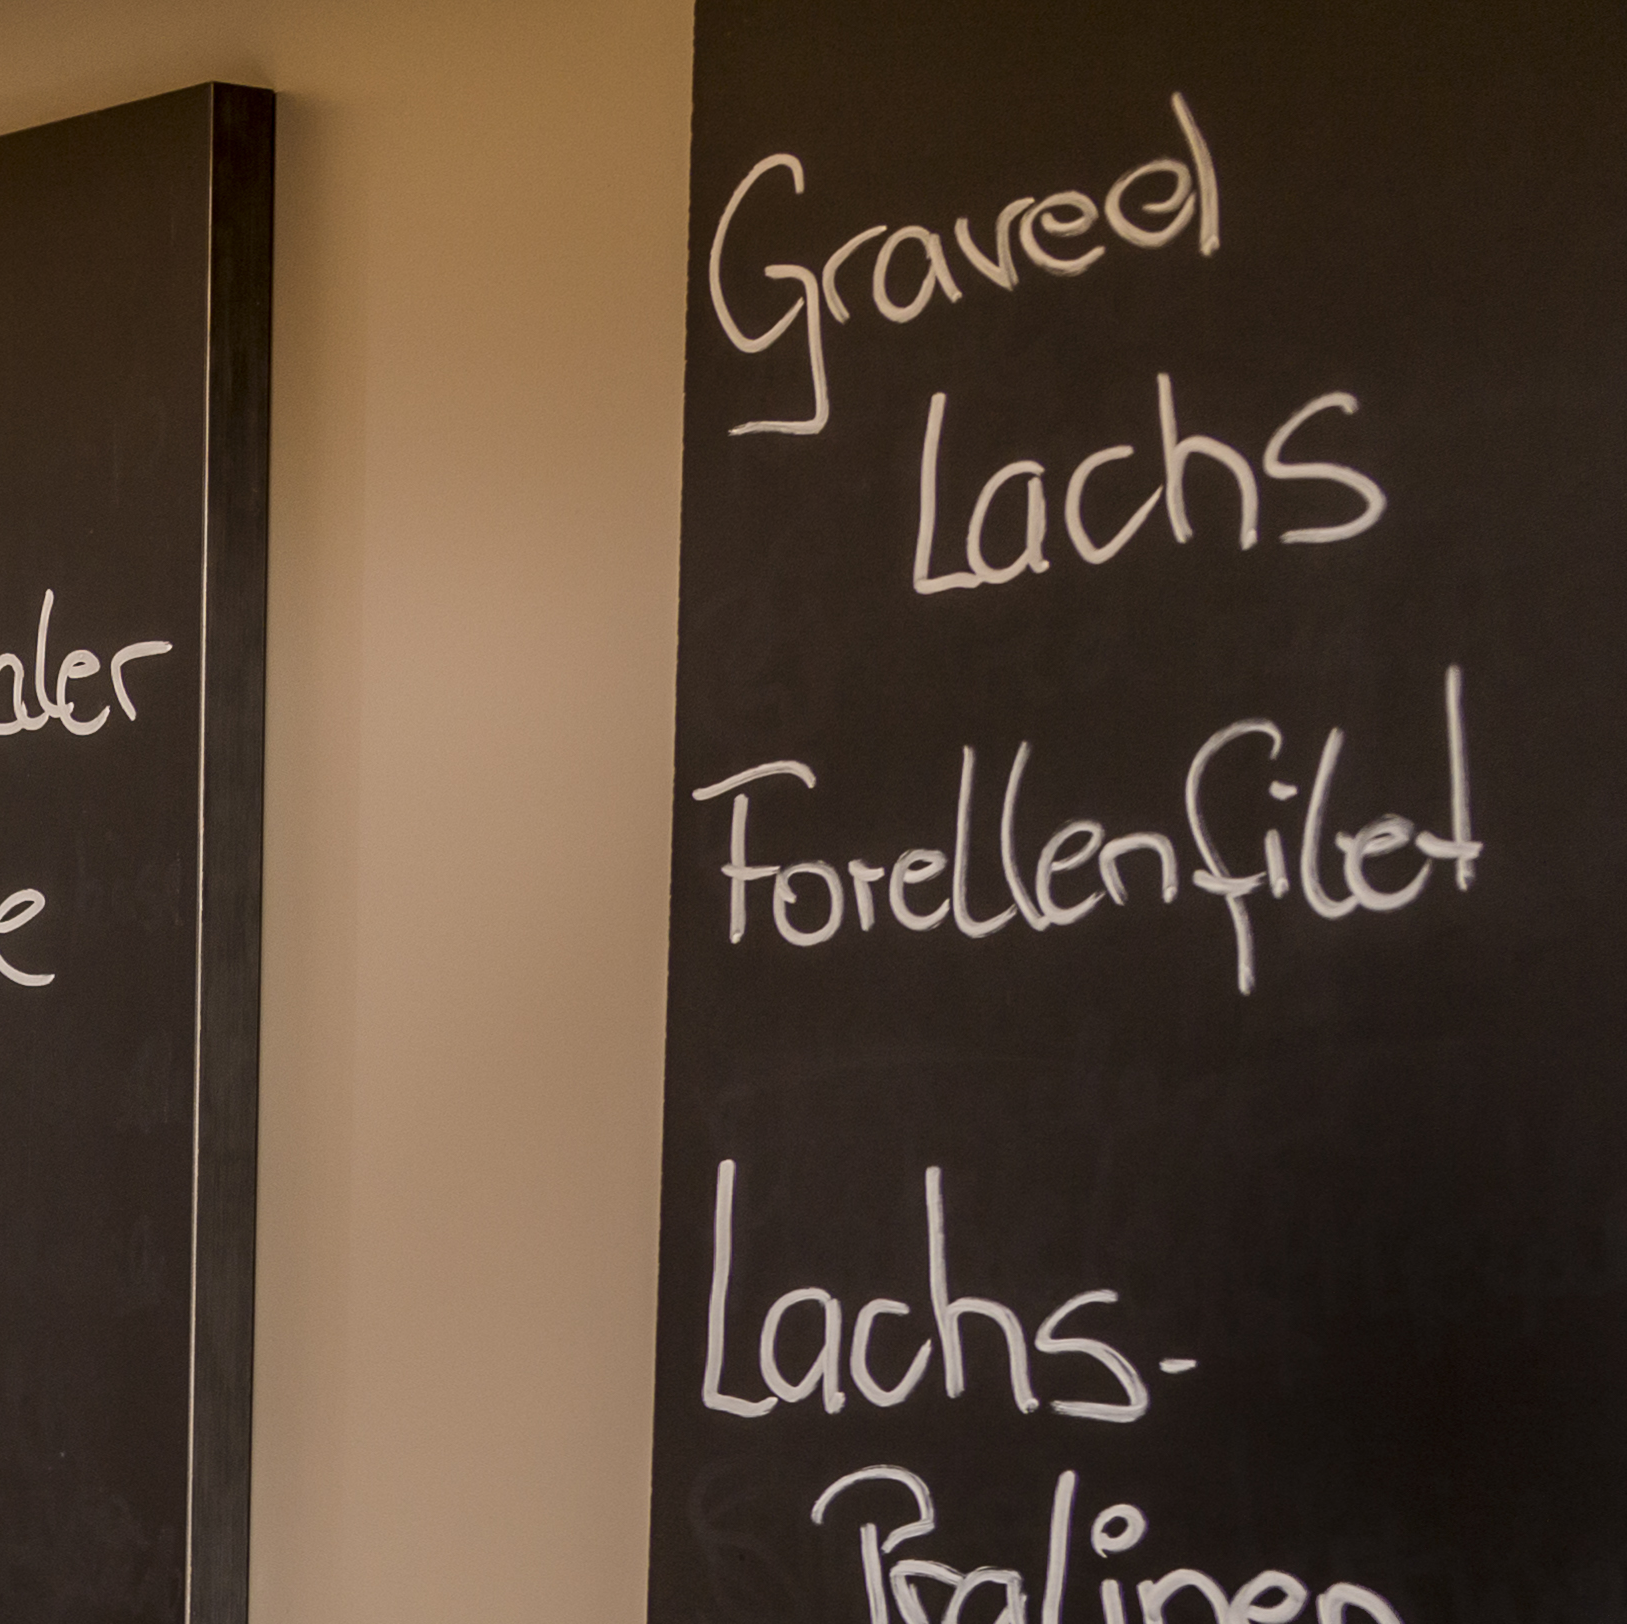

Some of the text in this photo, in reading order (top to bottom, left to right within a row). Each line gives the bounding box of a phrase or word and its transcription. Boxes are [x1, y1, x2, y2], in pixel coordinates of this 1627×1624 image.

[709, 92, 1220, 436] Graved
[913, 373, 1386, 594] Lachs
[692, 664, 1484, 996] Forellenfilet
[702, 1158, 1197, 1424] Lachs-
